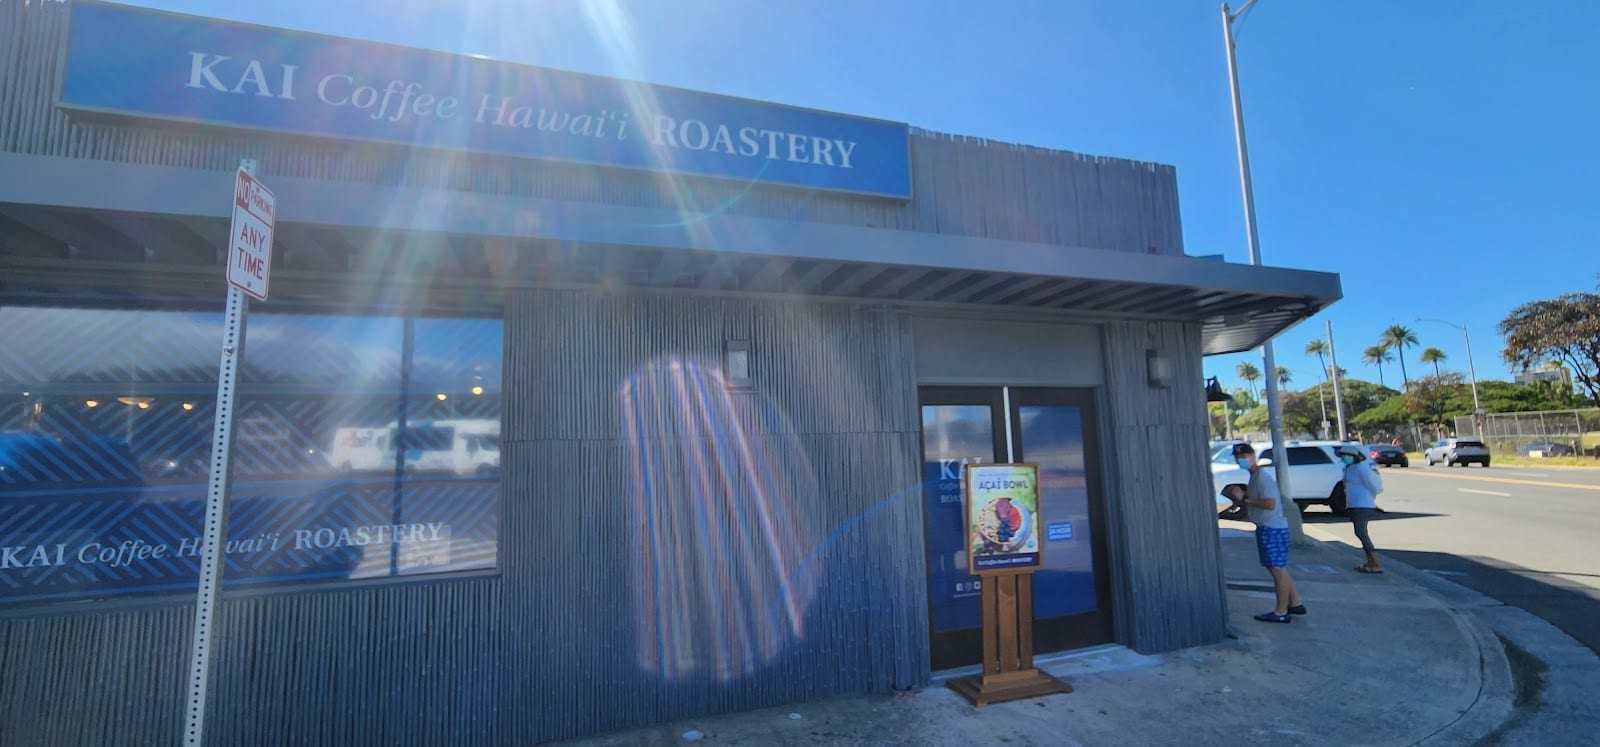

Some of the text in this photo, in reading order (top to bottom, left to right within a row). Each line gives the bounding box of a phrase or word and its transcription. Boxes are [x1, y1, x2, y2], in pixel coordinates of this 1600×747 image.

[185, 51, 299, 100] KAI
[317, 73, 458, 122] Coffee
[650, 116, 857, 169] ROASTERY
[238, 176, 272, 217] NO PARKING
[240, 222, 265, 252] ANY
[238, 247, 264, 280] TIME
[1003, 480, 1029, 489] BOWL
[0, 543, 67, 569] KAI
[78, 539, 167, 567] Coffee
[294, 522, 443, 550] ROASTERY
